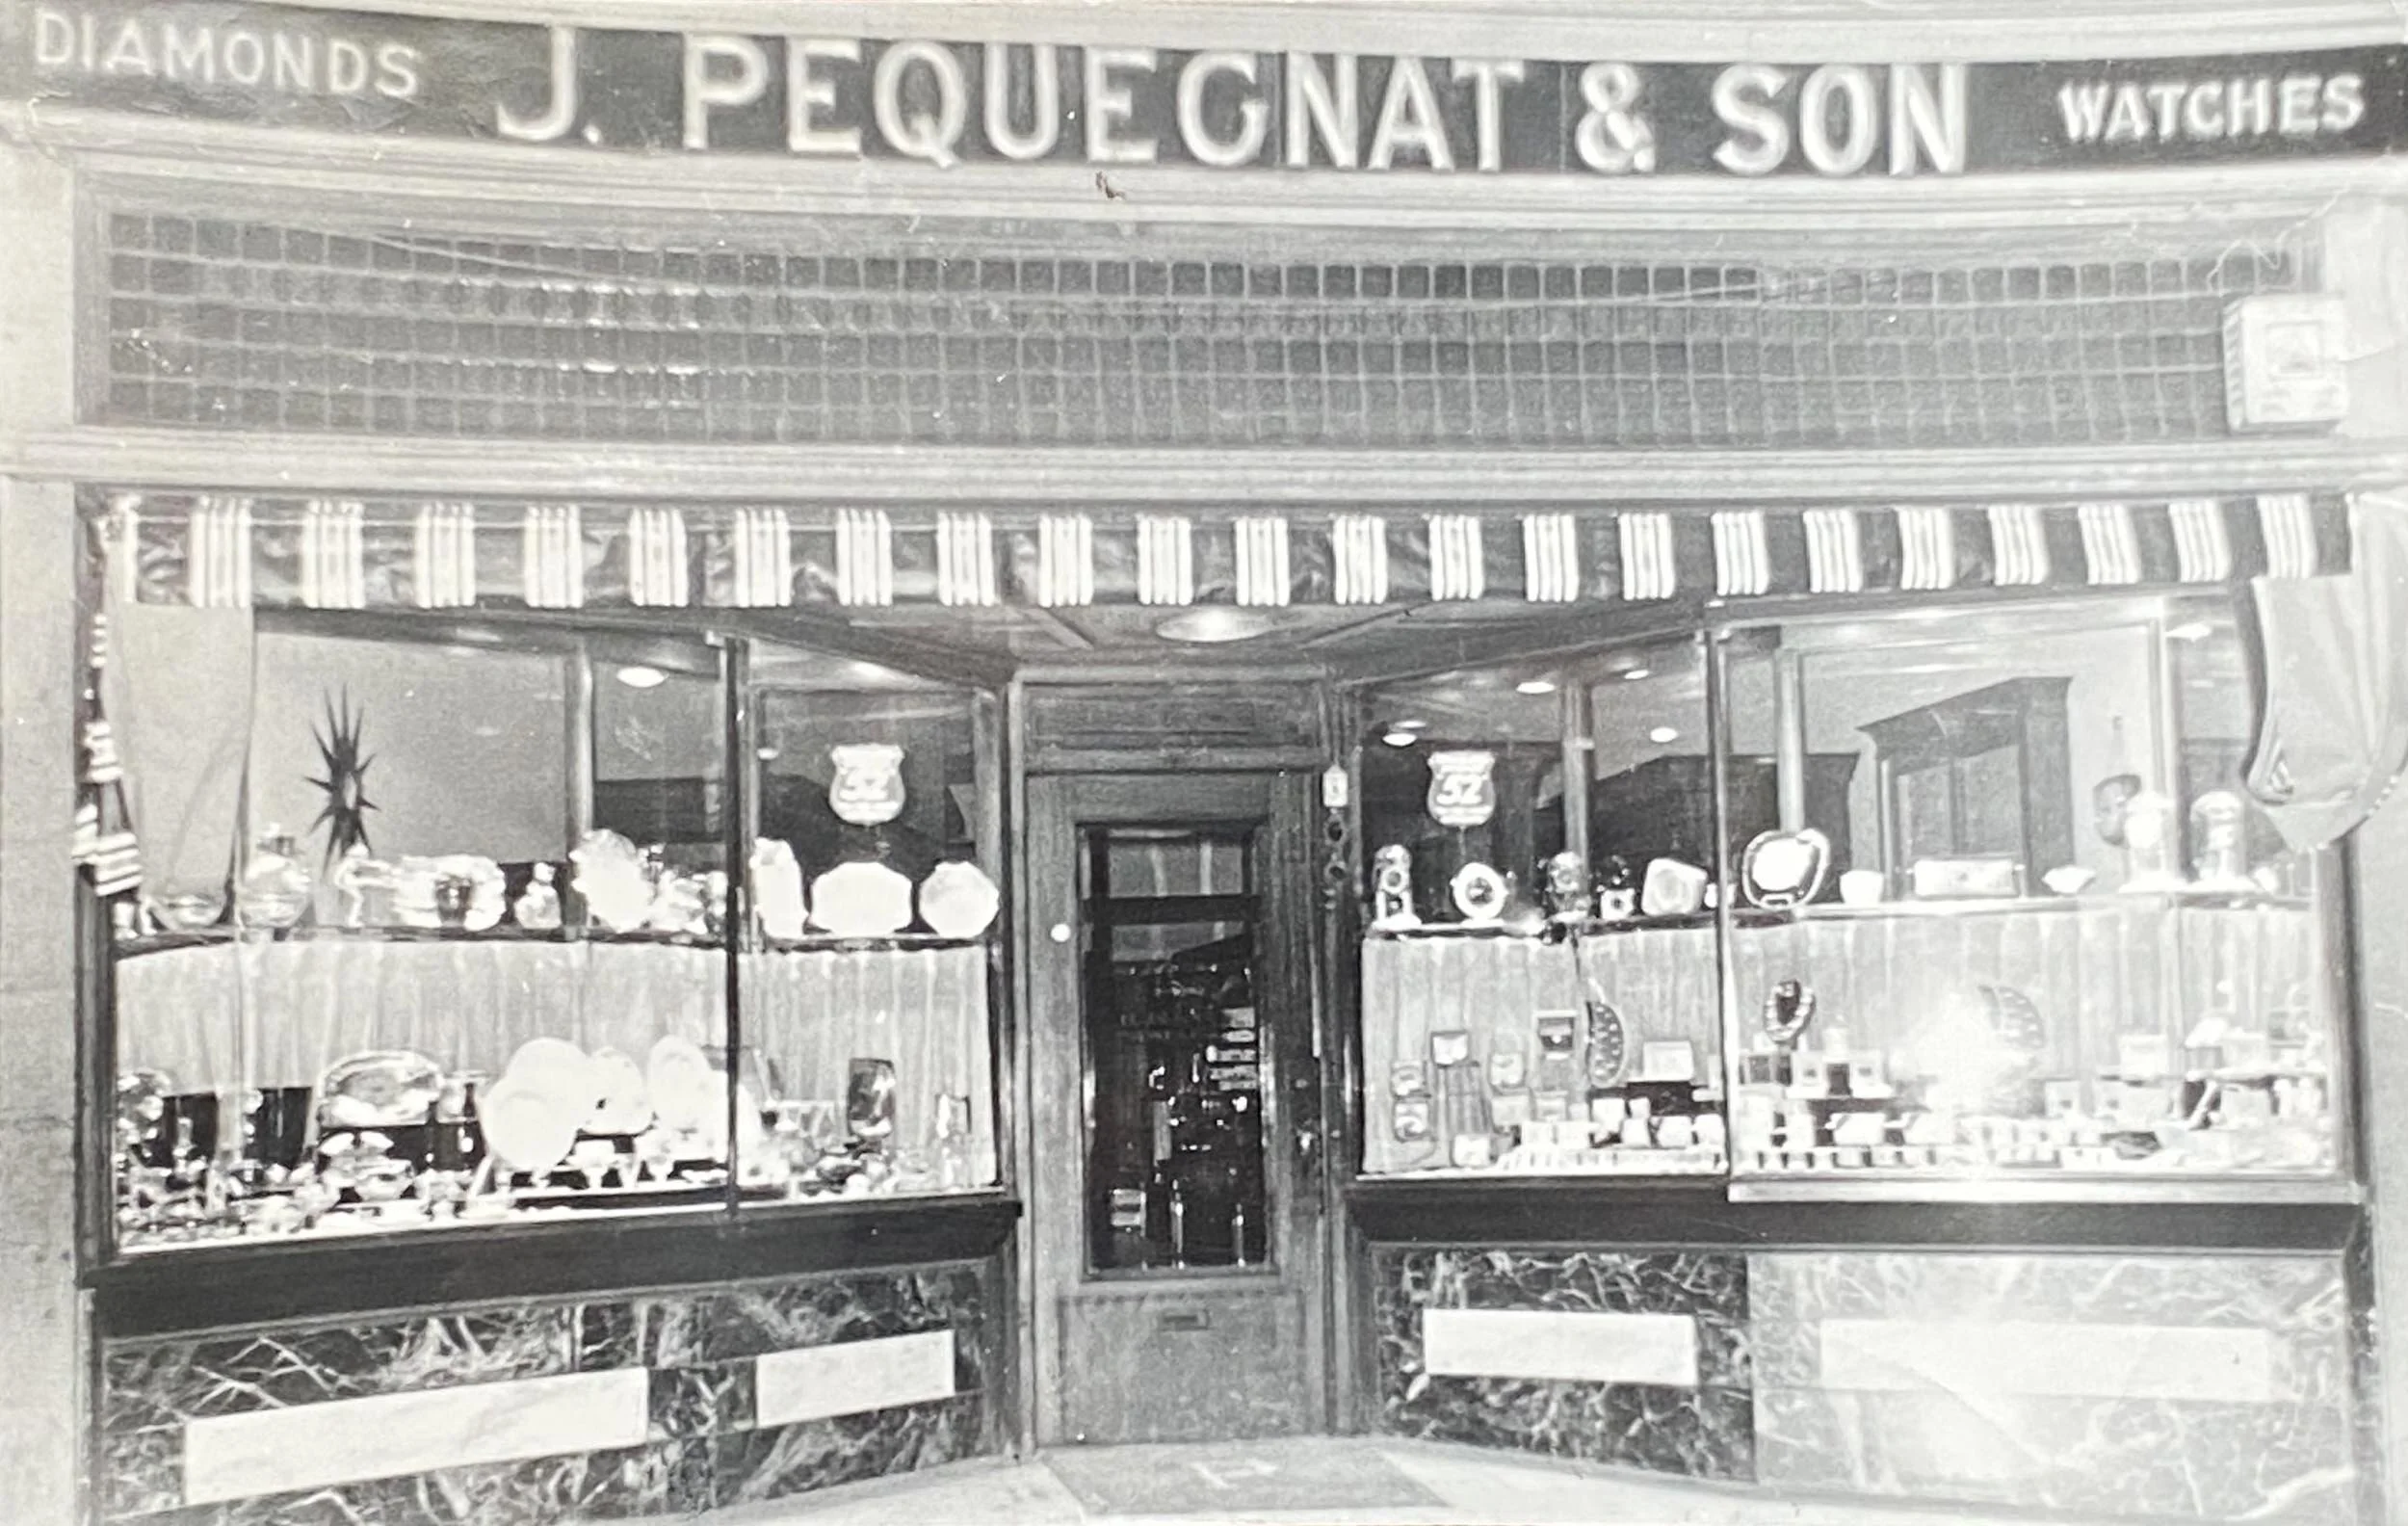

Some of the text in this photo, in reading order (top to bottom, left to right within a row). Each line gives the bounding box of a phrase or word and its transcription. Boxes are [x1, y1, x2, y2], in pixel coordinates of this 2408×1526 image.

[34, 14, 423, 98] DIAMONDS
[496, 26, 1968, 175] J. PEQUEGNAT & SON
[2056, 73, 2366, 145] WATCHES
